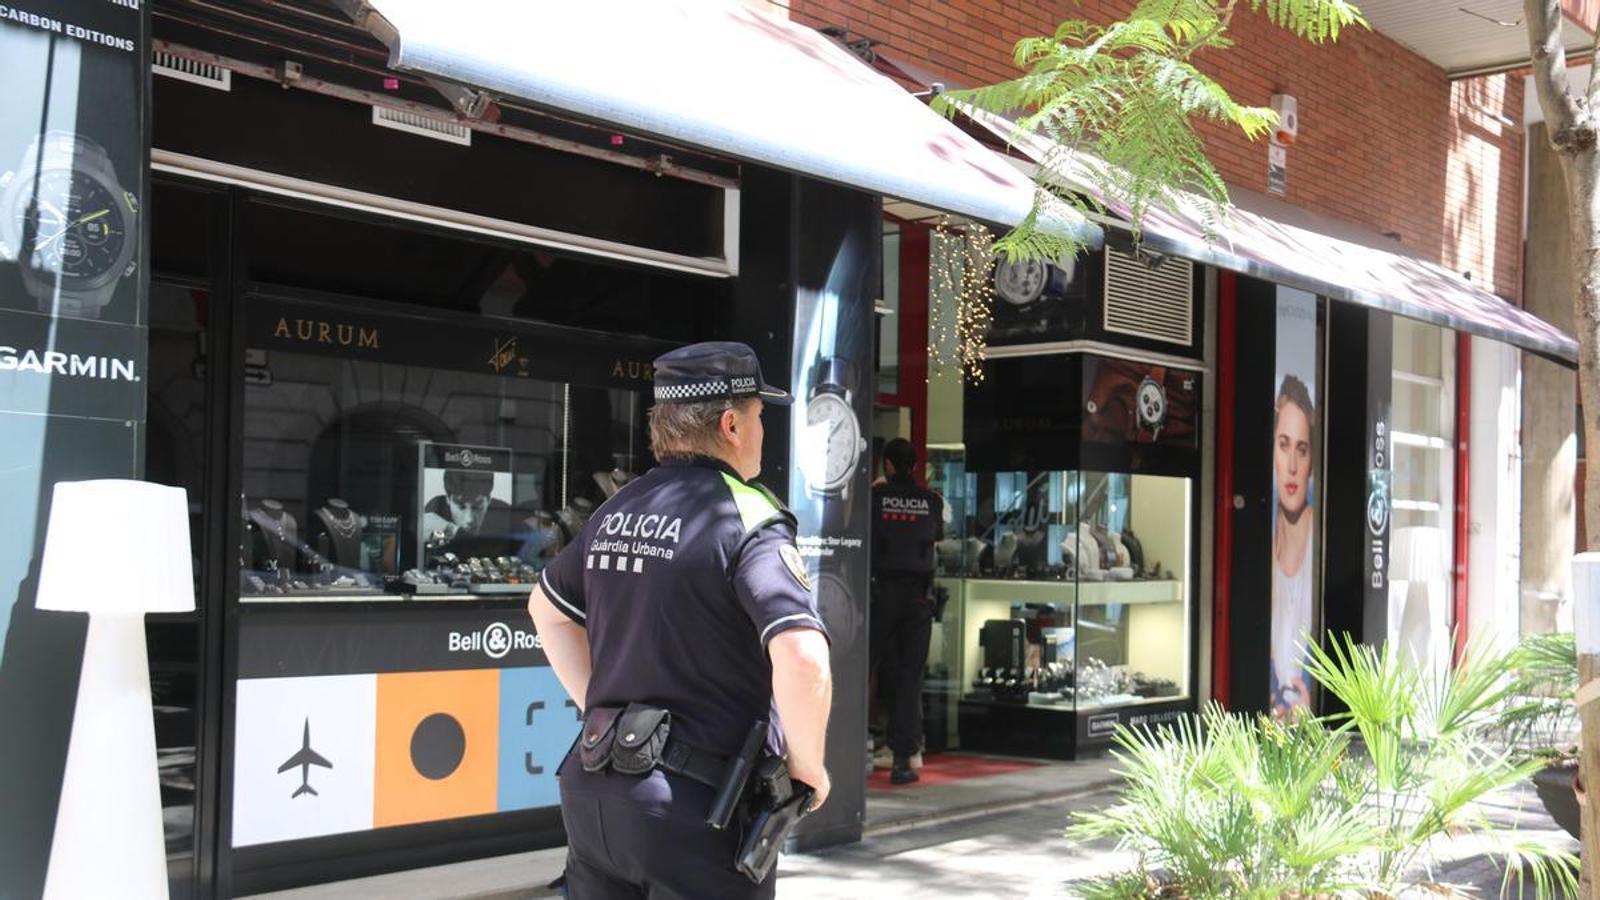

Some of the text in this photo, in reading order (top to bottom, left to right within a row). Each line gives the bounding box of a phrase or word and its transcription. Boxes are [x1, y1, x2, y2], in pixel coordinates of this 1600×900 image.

[0, 5, 135, 52] CARBON EDITIONS
[274, 317, 380, 349] AURUM
[731, 377, 756, 389] POLICIA
[1373, 421, 1386, 480] oss
[882, 496, 929, 509] POLICIA
[596, 511, 682, 543] POLICIA
[632, 541, 674, 560] Urbana
[1371, 540, 1384, 589] Bell
[449, 631, 480, 651] Bell
